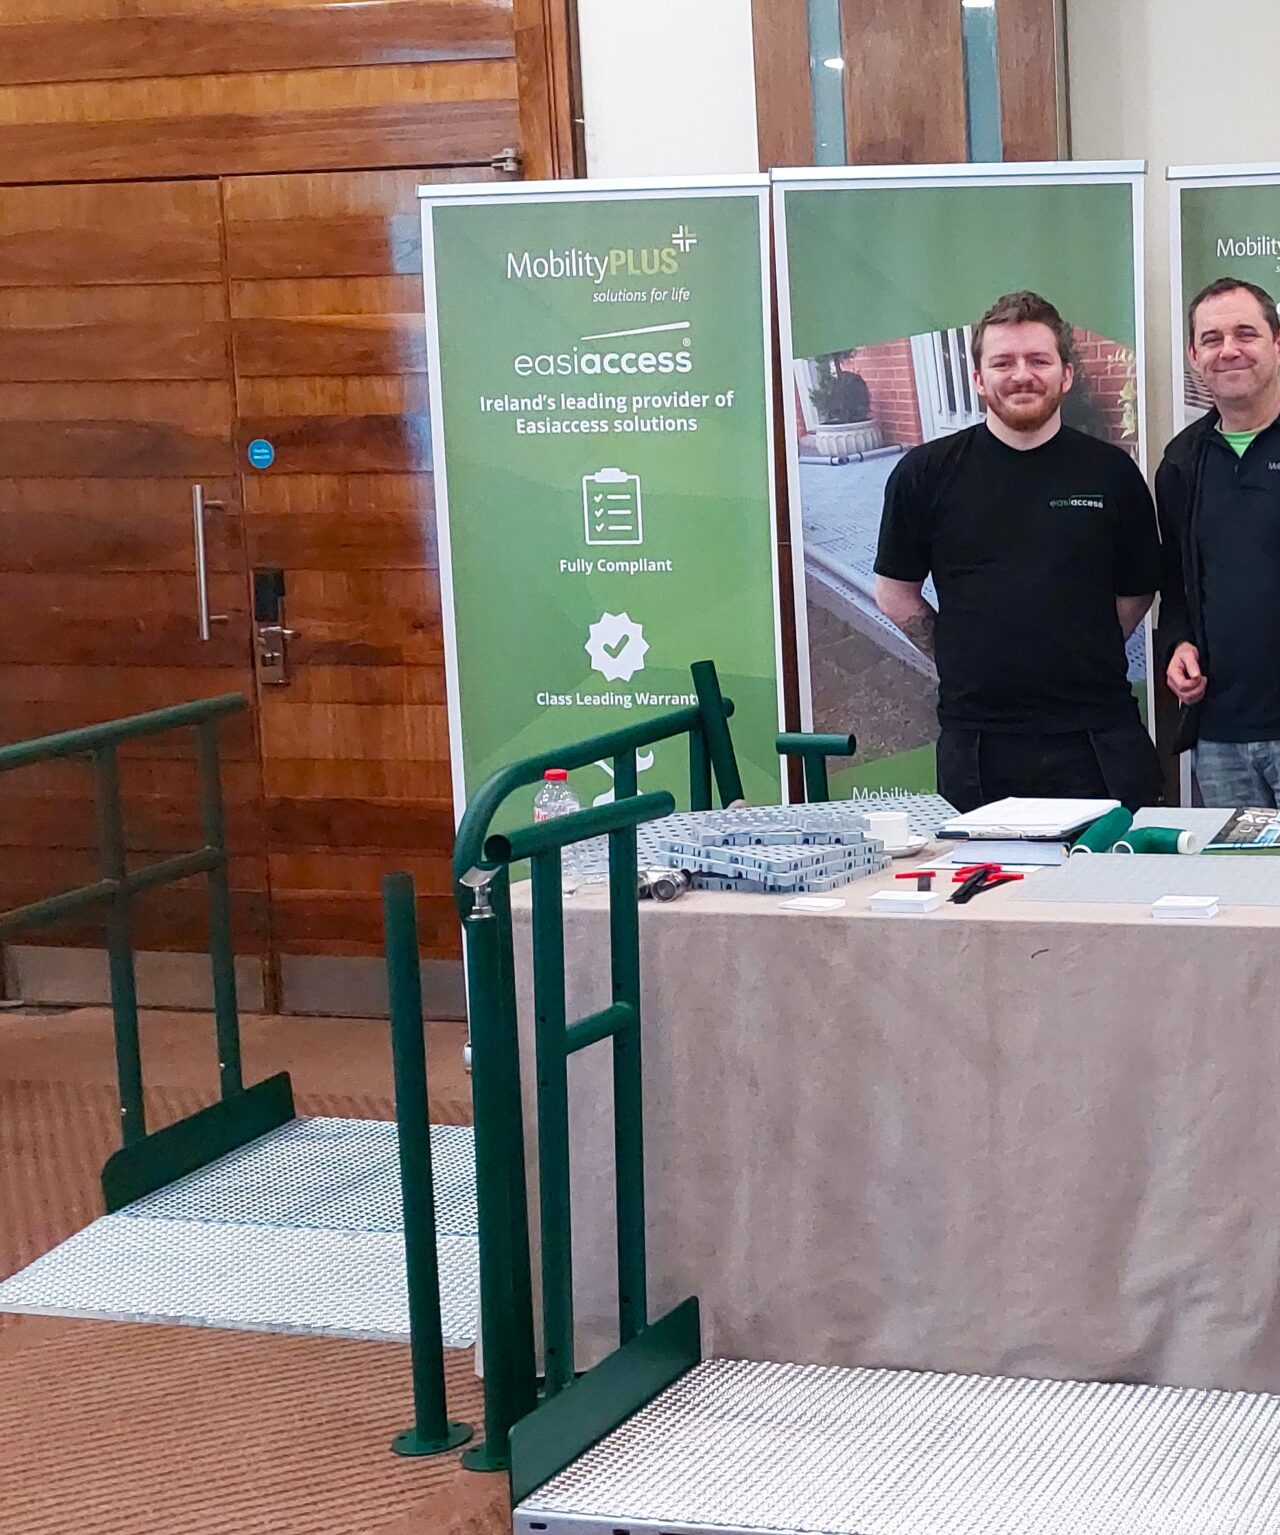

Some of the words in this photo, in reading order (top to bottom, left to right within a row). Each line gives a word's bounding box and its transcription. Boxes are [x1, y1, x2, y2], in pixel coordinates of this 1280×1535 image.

[506, 248, 680, 284] MobilityPLUS
[592, 288, 646, 304] solutions
[650, 287, 668, 303] for
[672, 286, 690, 302] life
[513, 347, 693, 376] easiaccess
[479, 394, 557, 413] Ireland's
[561, 393, 628, 413] leading
[632, 392, 710, 412] provider
[714, 390, 735, 408] of
[515, 419, 609, 435] Easiaccess
[613, 416, 698, 434] solutions
[559, 558, 594, 576] Fully
[596, 557, 673, 574] Compliant
[535, 693, 573, 706] Class
[576, 692, 632, 709] Leading
